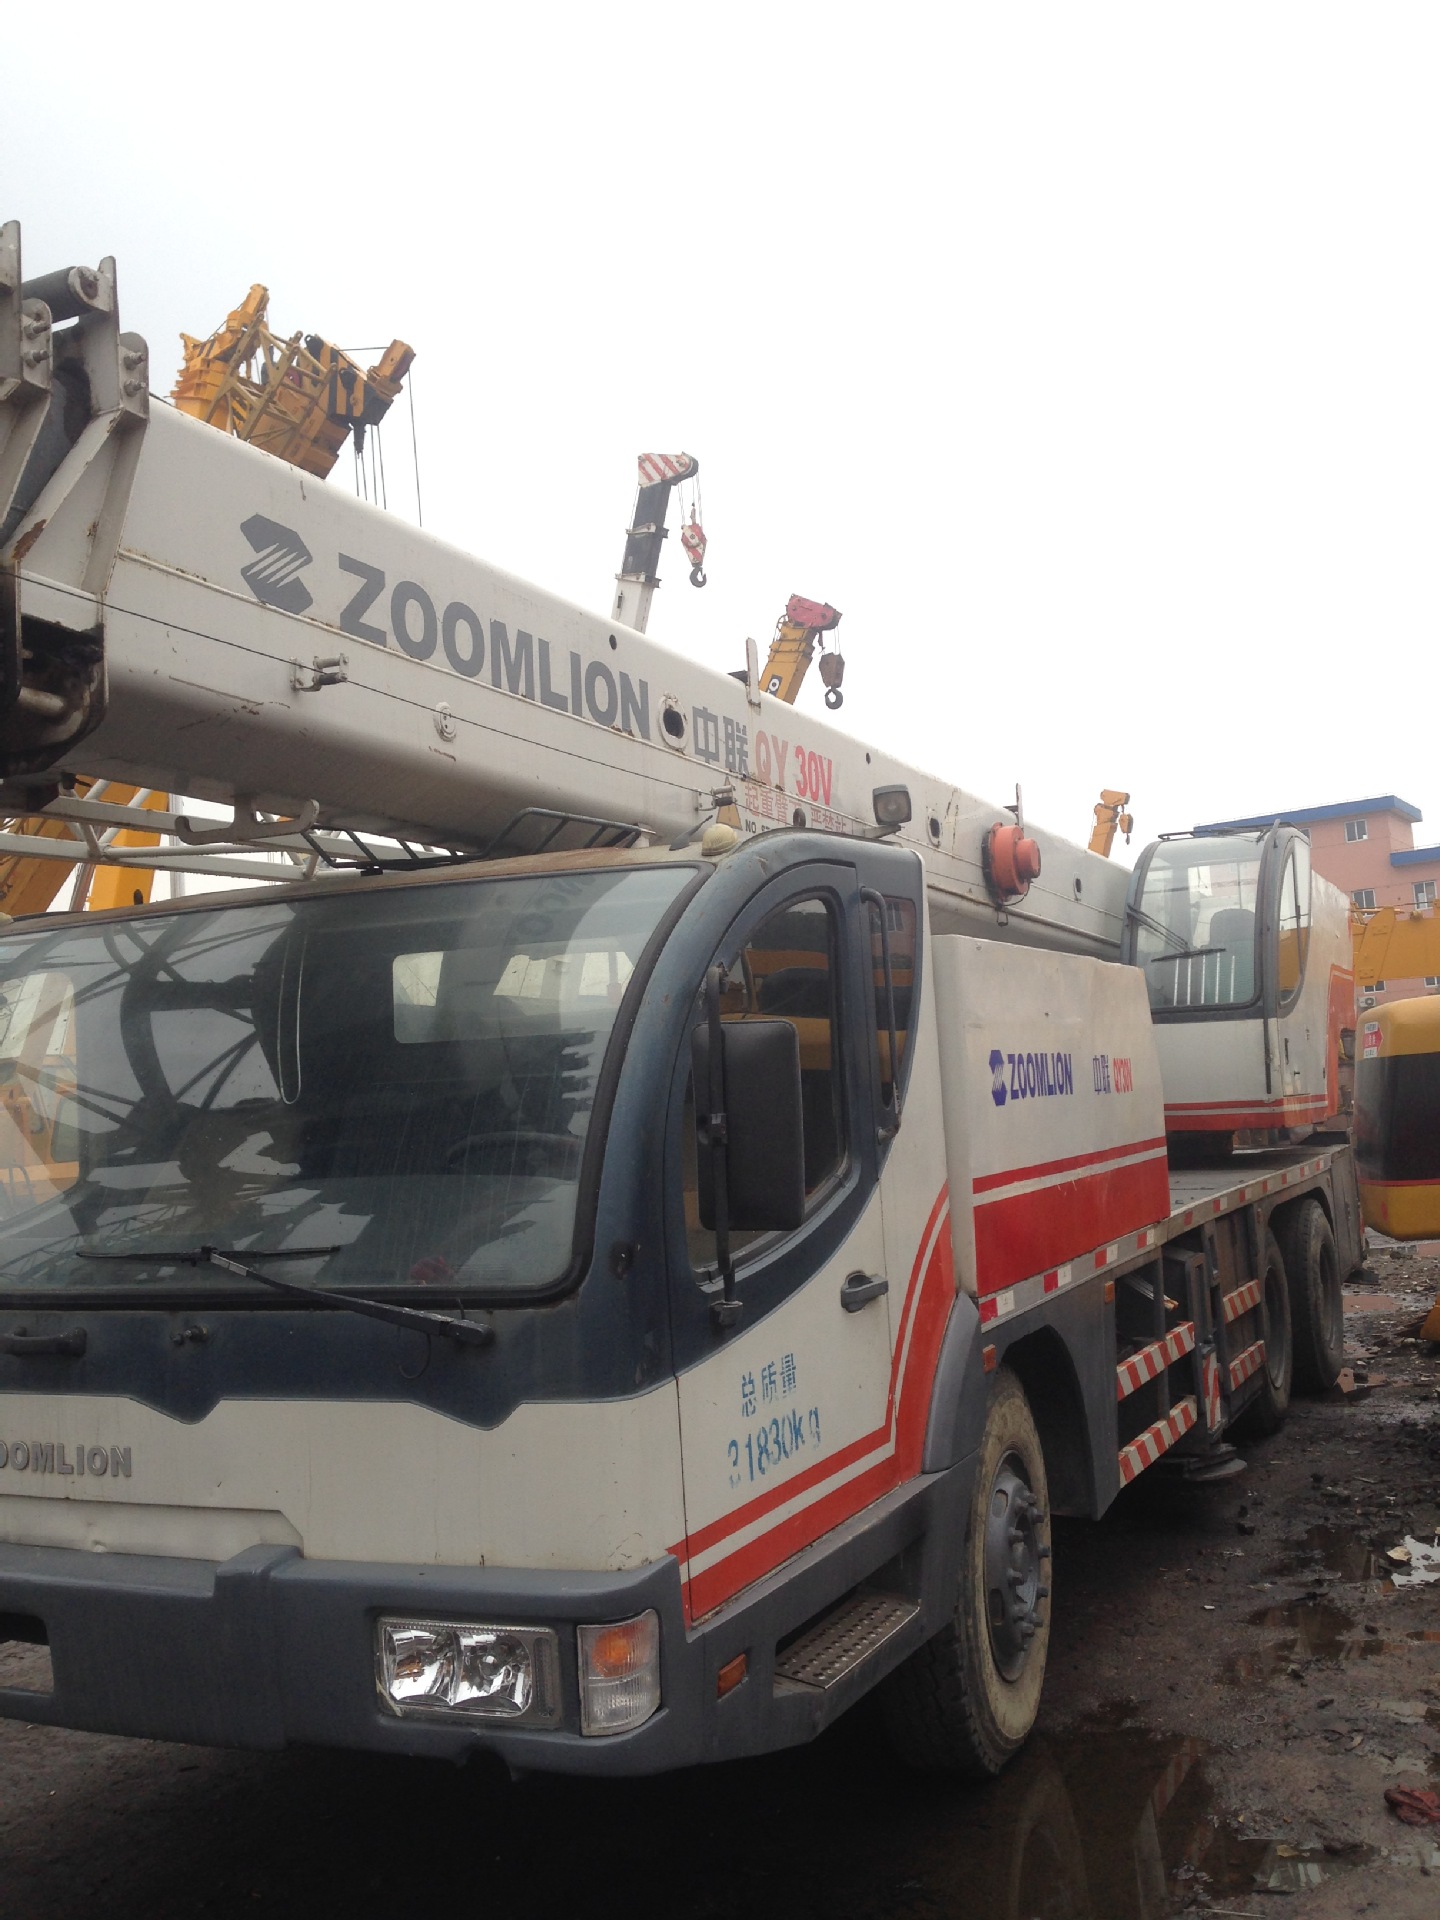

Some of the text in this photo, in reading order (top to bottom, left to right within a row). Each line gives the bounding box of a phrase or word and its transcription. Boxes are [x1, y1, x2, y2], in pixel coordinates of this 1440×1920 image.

[338, 552, 832, 806] ZOOMLION 中联 QY 30V
[745, 818, 757, 834] NO
[1007, 1052, 1073, 1100] ZOOMLION
[741, 1353, 797, 1417] 总质量
